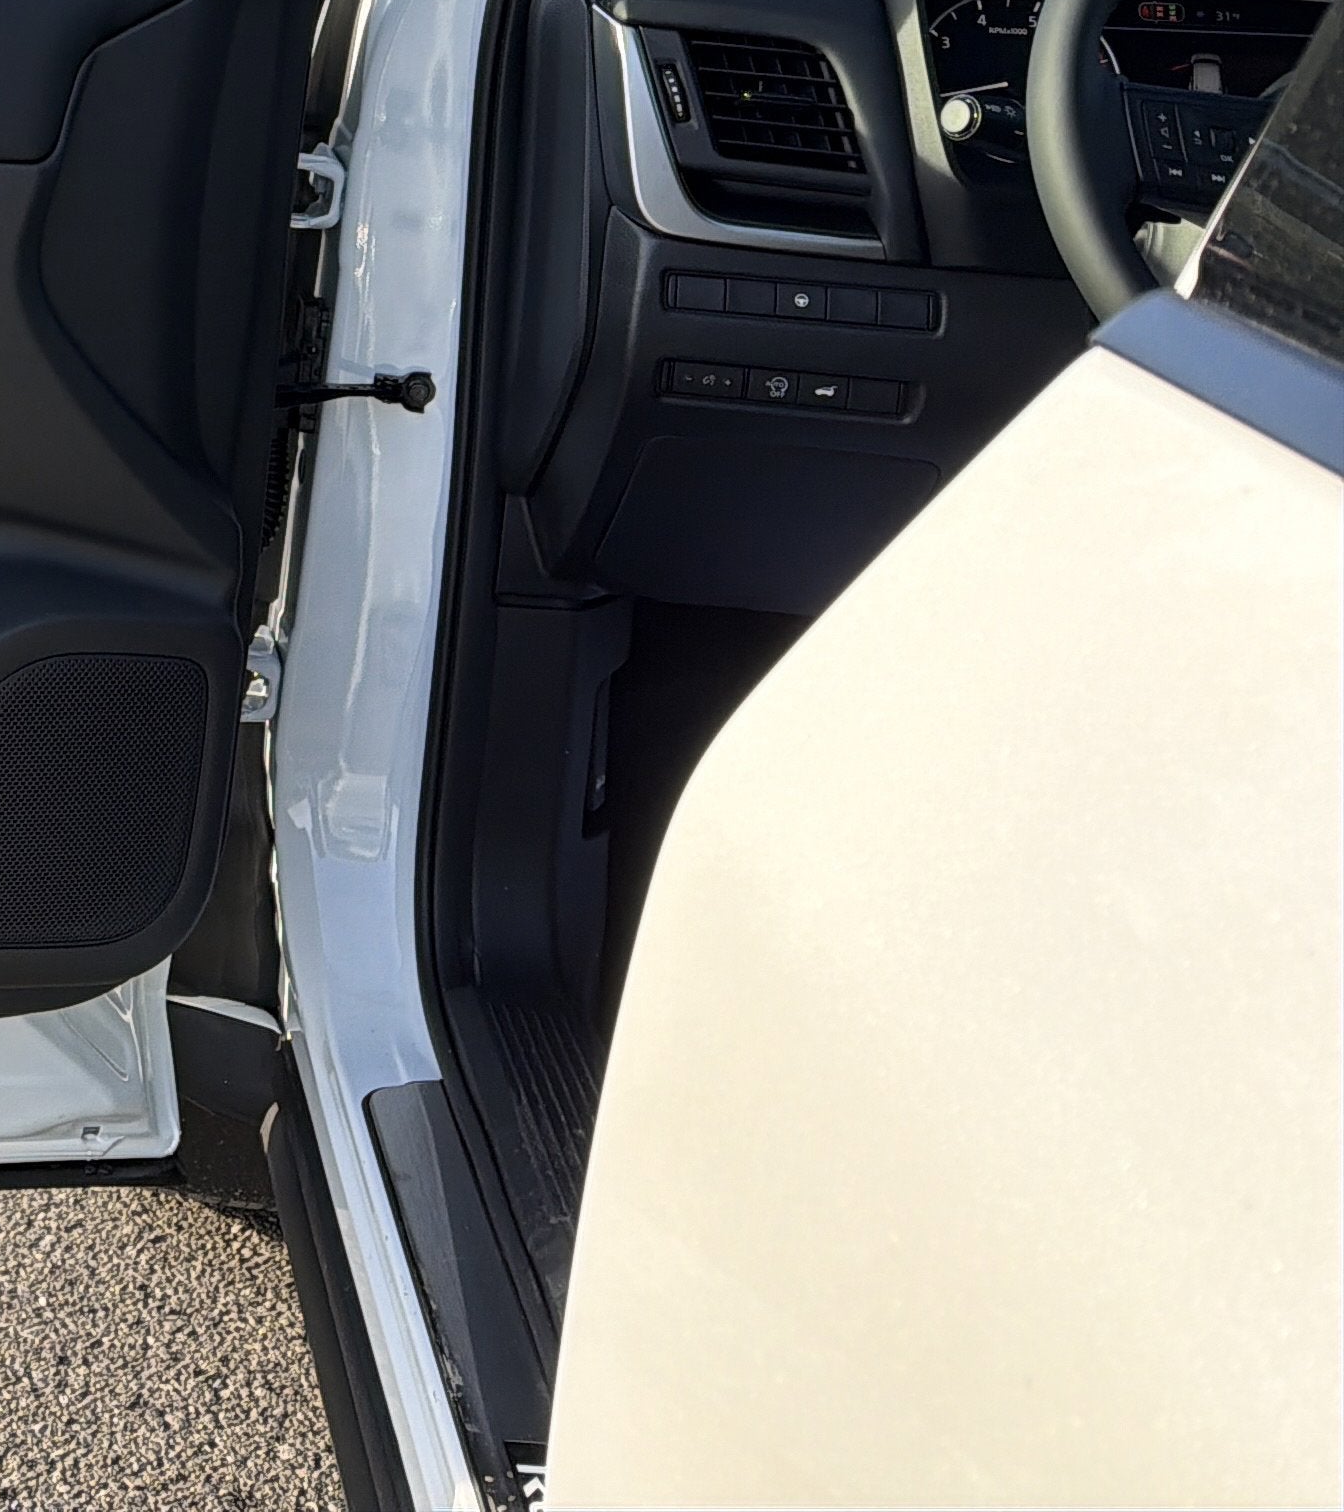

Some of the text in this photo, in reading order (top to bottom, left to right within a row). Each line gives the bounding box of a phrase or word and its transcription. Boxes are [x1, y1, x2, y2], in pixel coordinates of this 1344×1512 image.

[976, 14, 987, 27] 4
[1028, 15, 1038, 28] 5
[941, 36, 951, 49] 3
[769, 390, 785, 398] OFF
